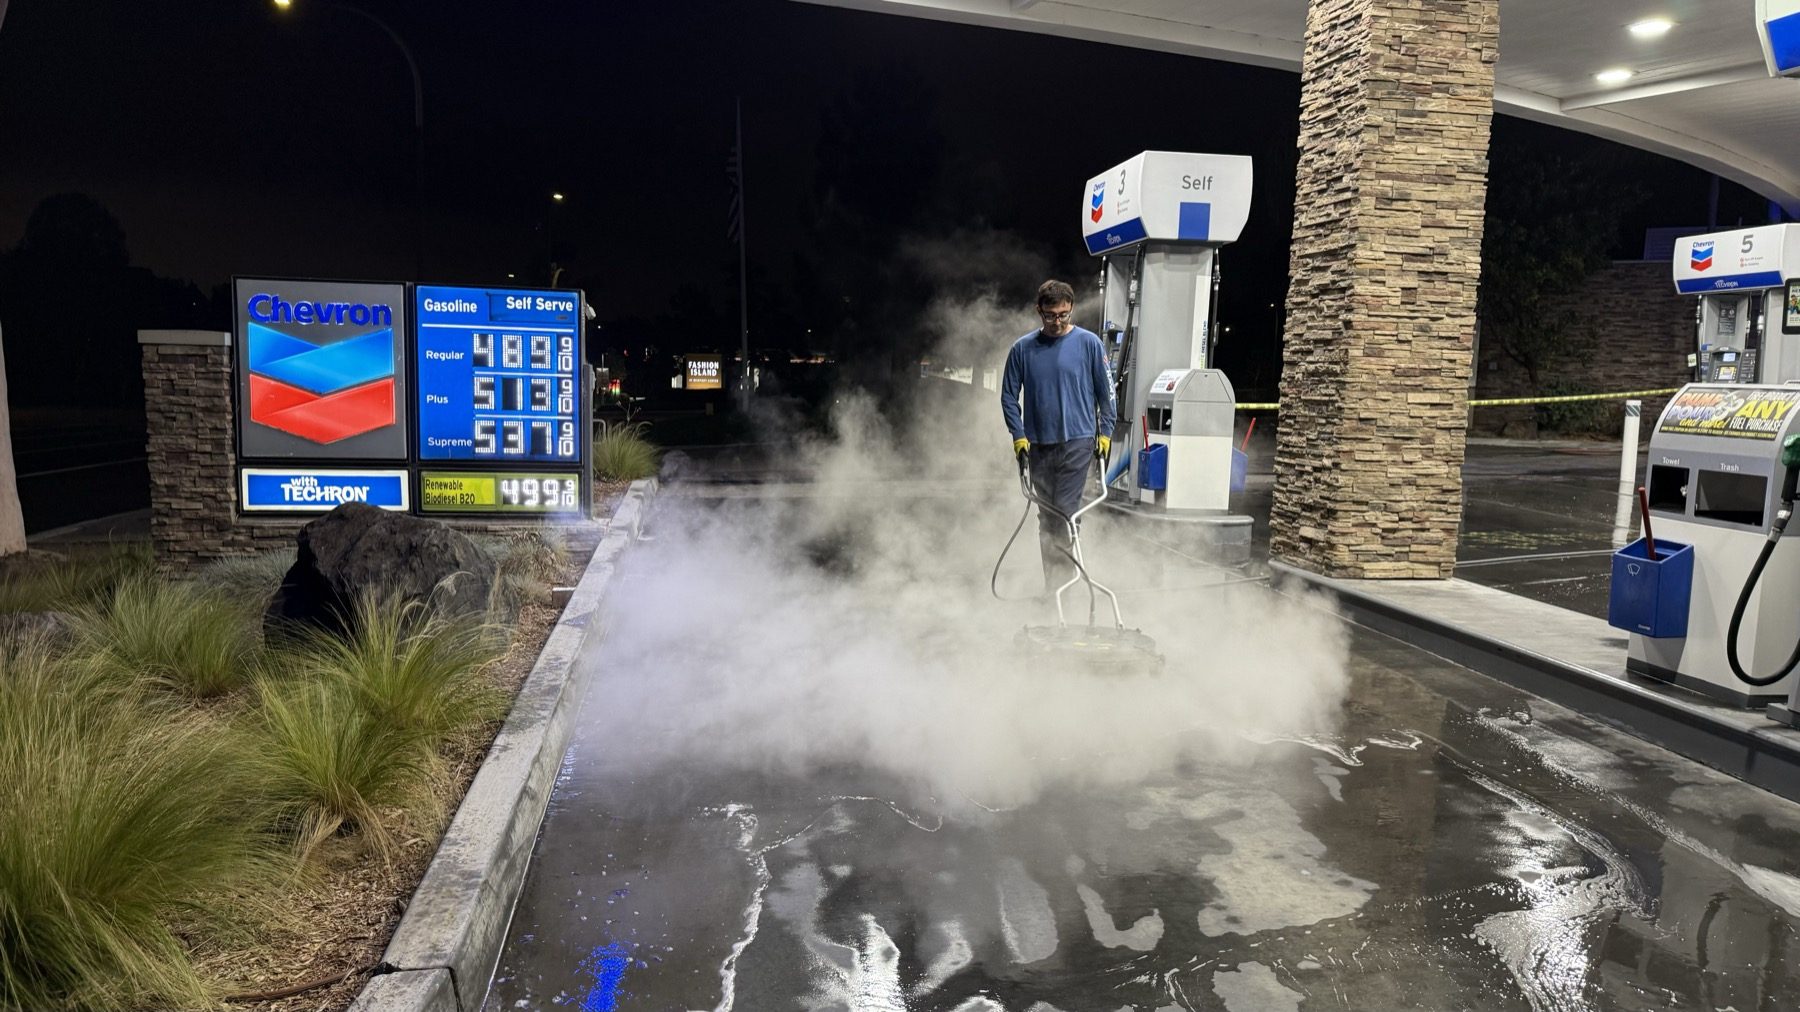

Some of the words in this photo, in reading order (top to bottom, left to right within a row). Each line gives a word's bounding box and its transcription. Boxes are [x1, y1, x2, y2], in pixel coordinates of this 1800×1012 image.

[1118, 169, 1126, 195] 3
[1182, 175, 1213, 190] Self
[1692, 240, 1714, 248] Chevron
[1741, 234, 1754, 253] 5
[247, 293, 392, 326] Chevron
[424, 298, 477, 313] Gasoline
[506, 296, 532, 310] Self
[536, 297, 573, 312] Serve
[426, 350, 464, 361] Regular
[473, 333, 551, 369] 489
[688, 361, 719, 369] FASHION
[426, 394, 449, 404] Plus
[474, 377, 551, 411] 513
[1735, 399, 1793, 420] ANY
[1729, 416, 1746, 429] FUEL
[1745, 418, 1783, 432] PURCHASE
[427, 437, 472, 447] Supreme
[475, 420, 552, 454] 537
[1662, 456, 1680, 465] Towel
[1720, 463, 1740, 472] Trash
[290, 476, 318, 487] with
[425, 479, 463, 490] Renewable
[280, 483, 368, 504] TECHRON
[425, 493, 458, 505] Biodiesel
[459, 493, 476, 505] B20
[502, 478, 559, 505] 499
